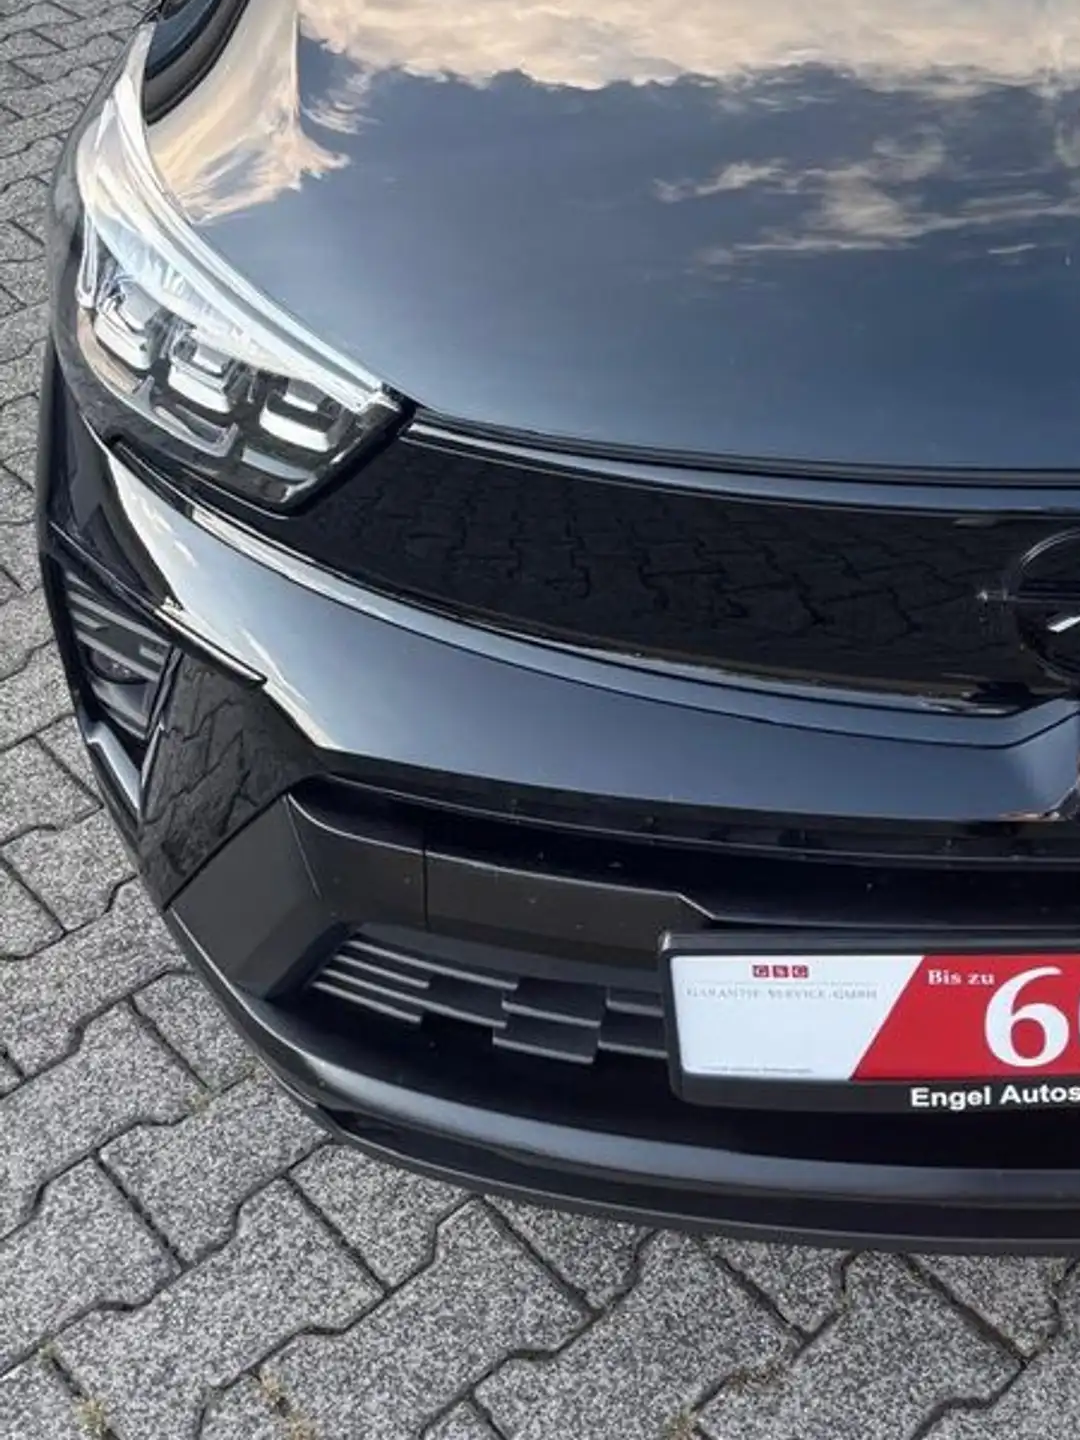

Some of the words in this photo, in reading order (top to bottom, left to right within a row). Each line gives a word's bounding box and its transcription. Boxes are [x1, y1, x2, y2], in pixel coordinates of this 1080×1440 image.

[927, 969, 962, 985] Bis
[967, 972, 995, 985] zu
[910, 1085, 992, 1111] Engel
